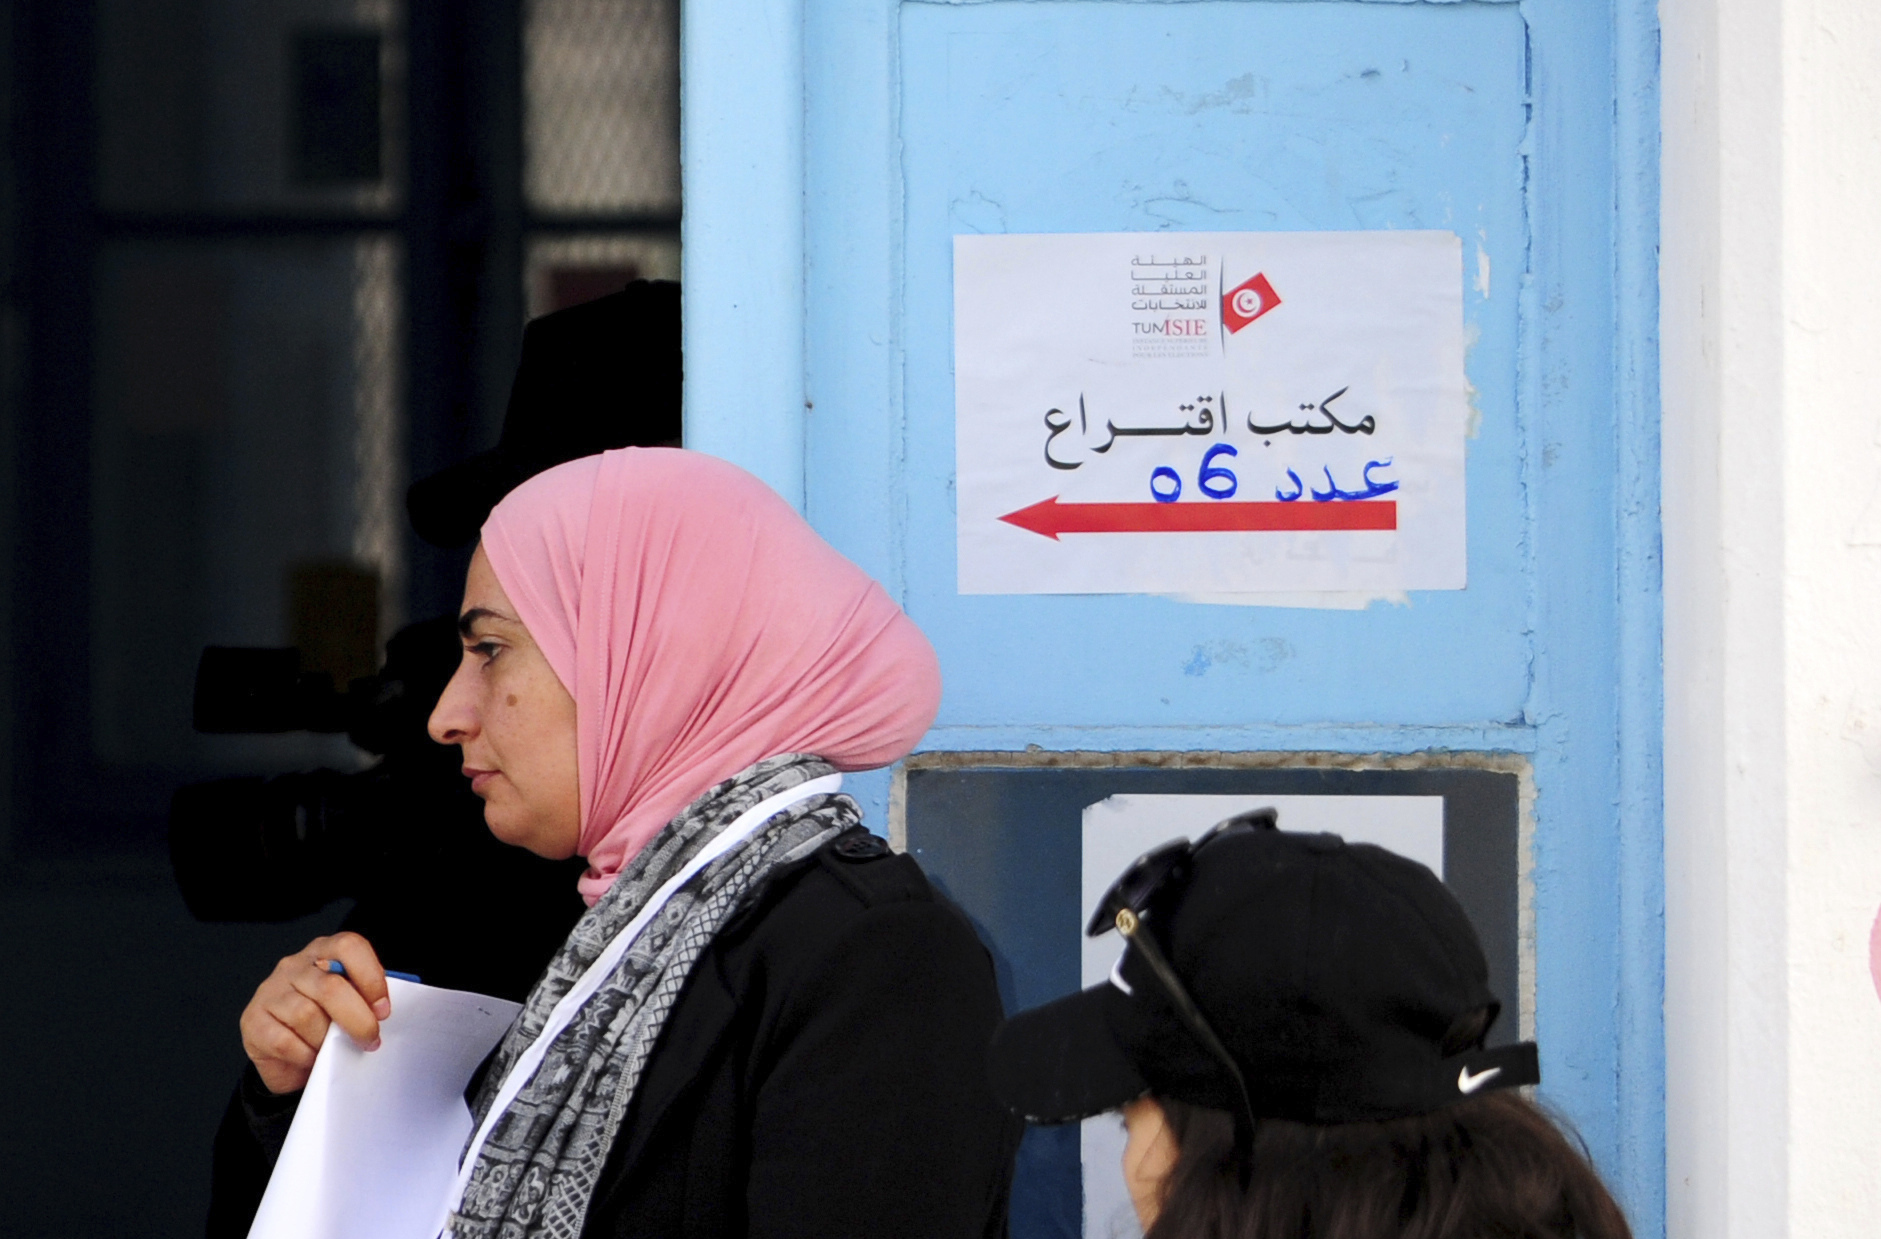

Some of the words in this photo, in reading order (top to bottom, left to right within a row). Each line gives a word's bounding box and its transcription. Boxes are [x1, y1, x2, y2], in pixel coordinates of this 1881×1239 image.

[1131, 255, 1206, 268] الهيئة
[1131, 269, 1207, 283] العليا
[1131, 284, 1207, 296] المستقلة
[1131, 299, 1207, 313] للانتخابات
[1246, 385, 1376, 448] مكتب
[1043, 390, 1228, 471] اقتراع
[1274, 455, 1400, 503] عدد
